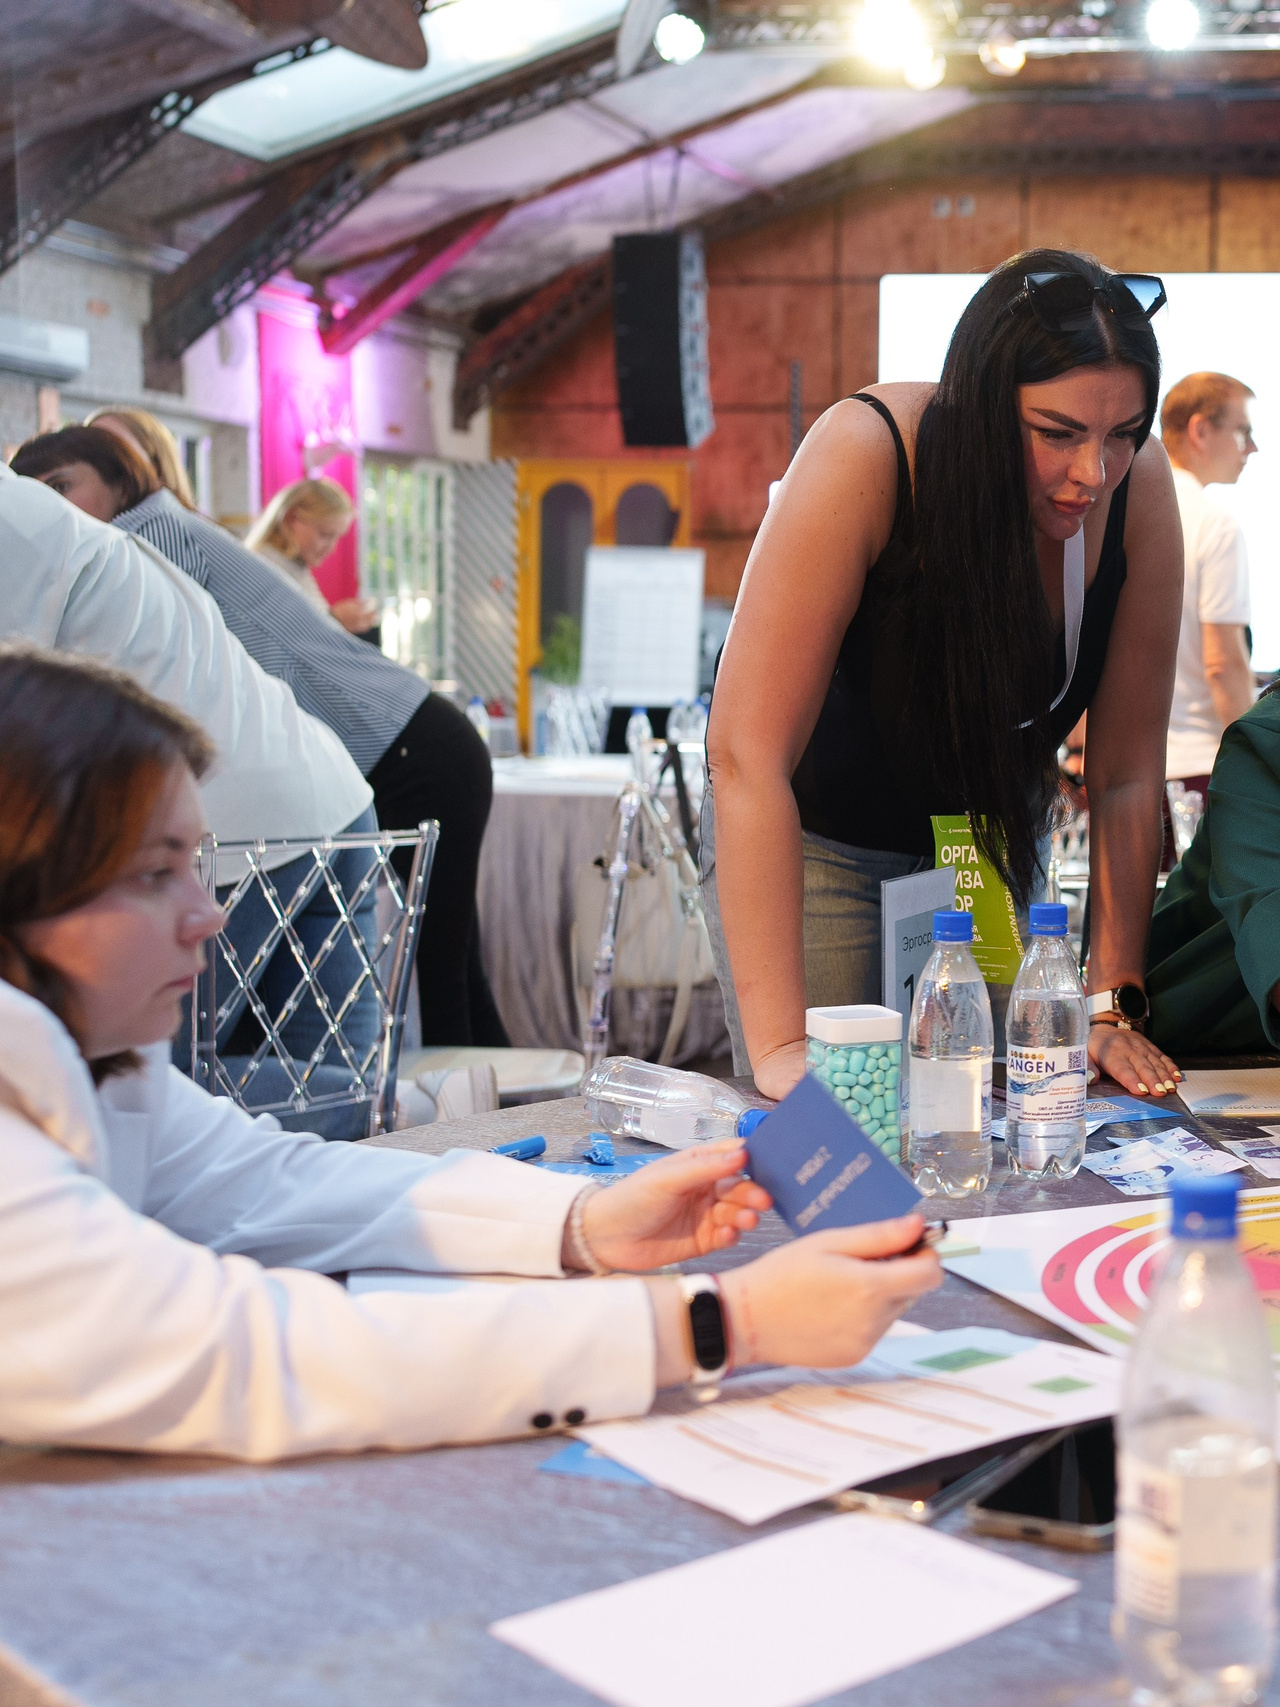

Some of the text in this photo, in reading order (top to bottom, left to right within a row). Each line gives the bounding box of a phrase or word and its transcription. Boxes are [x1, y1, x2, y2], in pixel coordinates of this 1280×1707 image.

[941, 845, 979, 864] ОРГА
[955, 870, 985, 889] ИЗА
[955, 895, 974, 912] ОР
